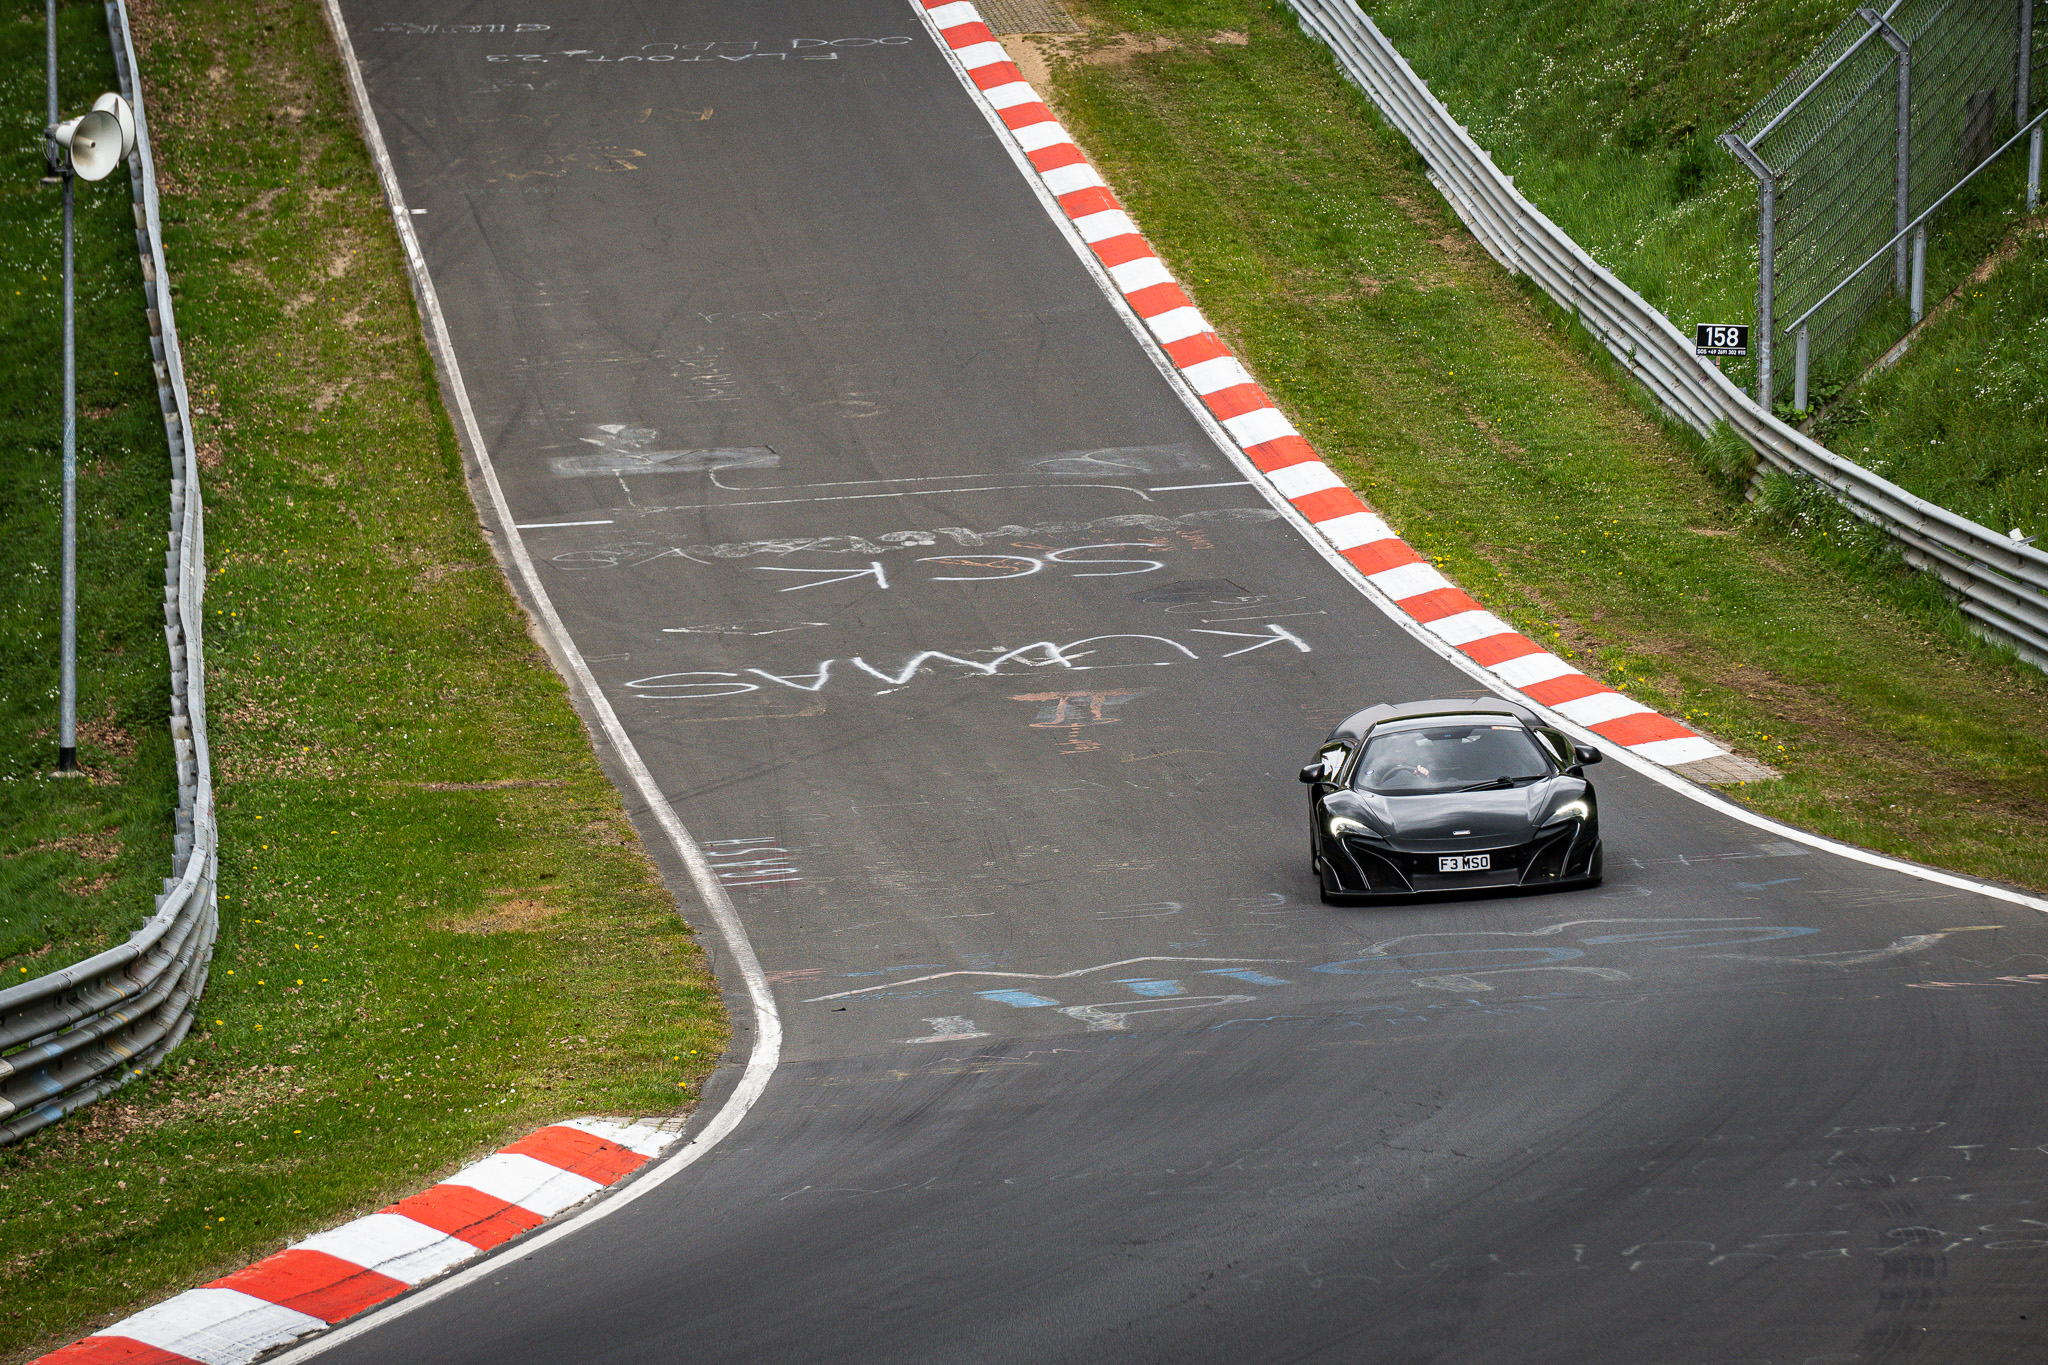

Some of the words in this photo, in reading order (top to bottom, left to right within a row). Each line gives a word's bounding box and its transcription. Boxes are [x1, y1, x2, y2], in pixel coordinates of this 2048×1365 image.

[1706, 327, 1739, 347] 158
[754, 541, 1165, 592] SCK
[1440, 858, 1458, 870] F3
[1462, 856, 1488, 869] MSO
